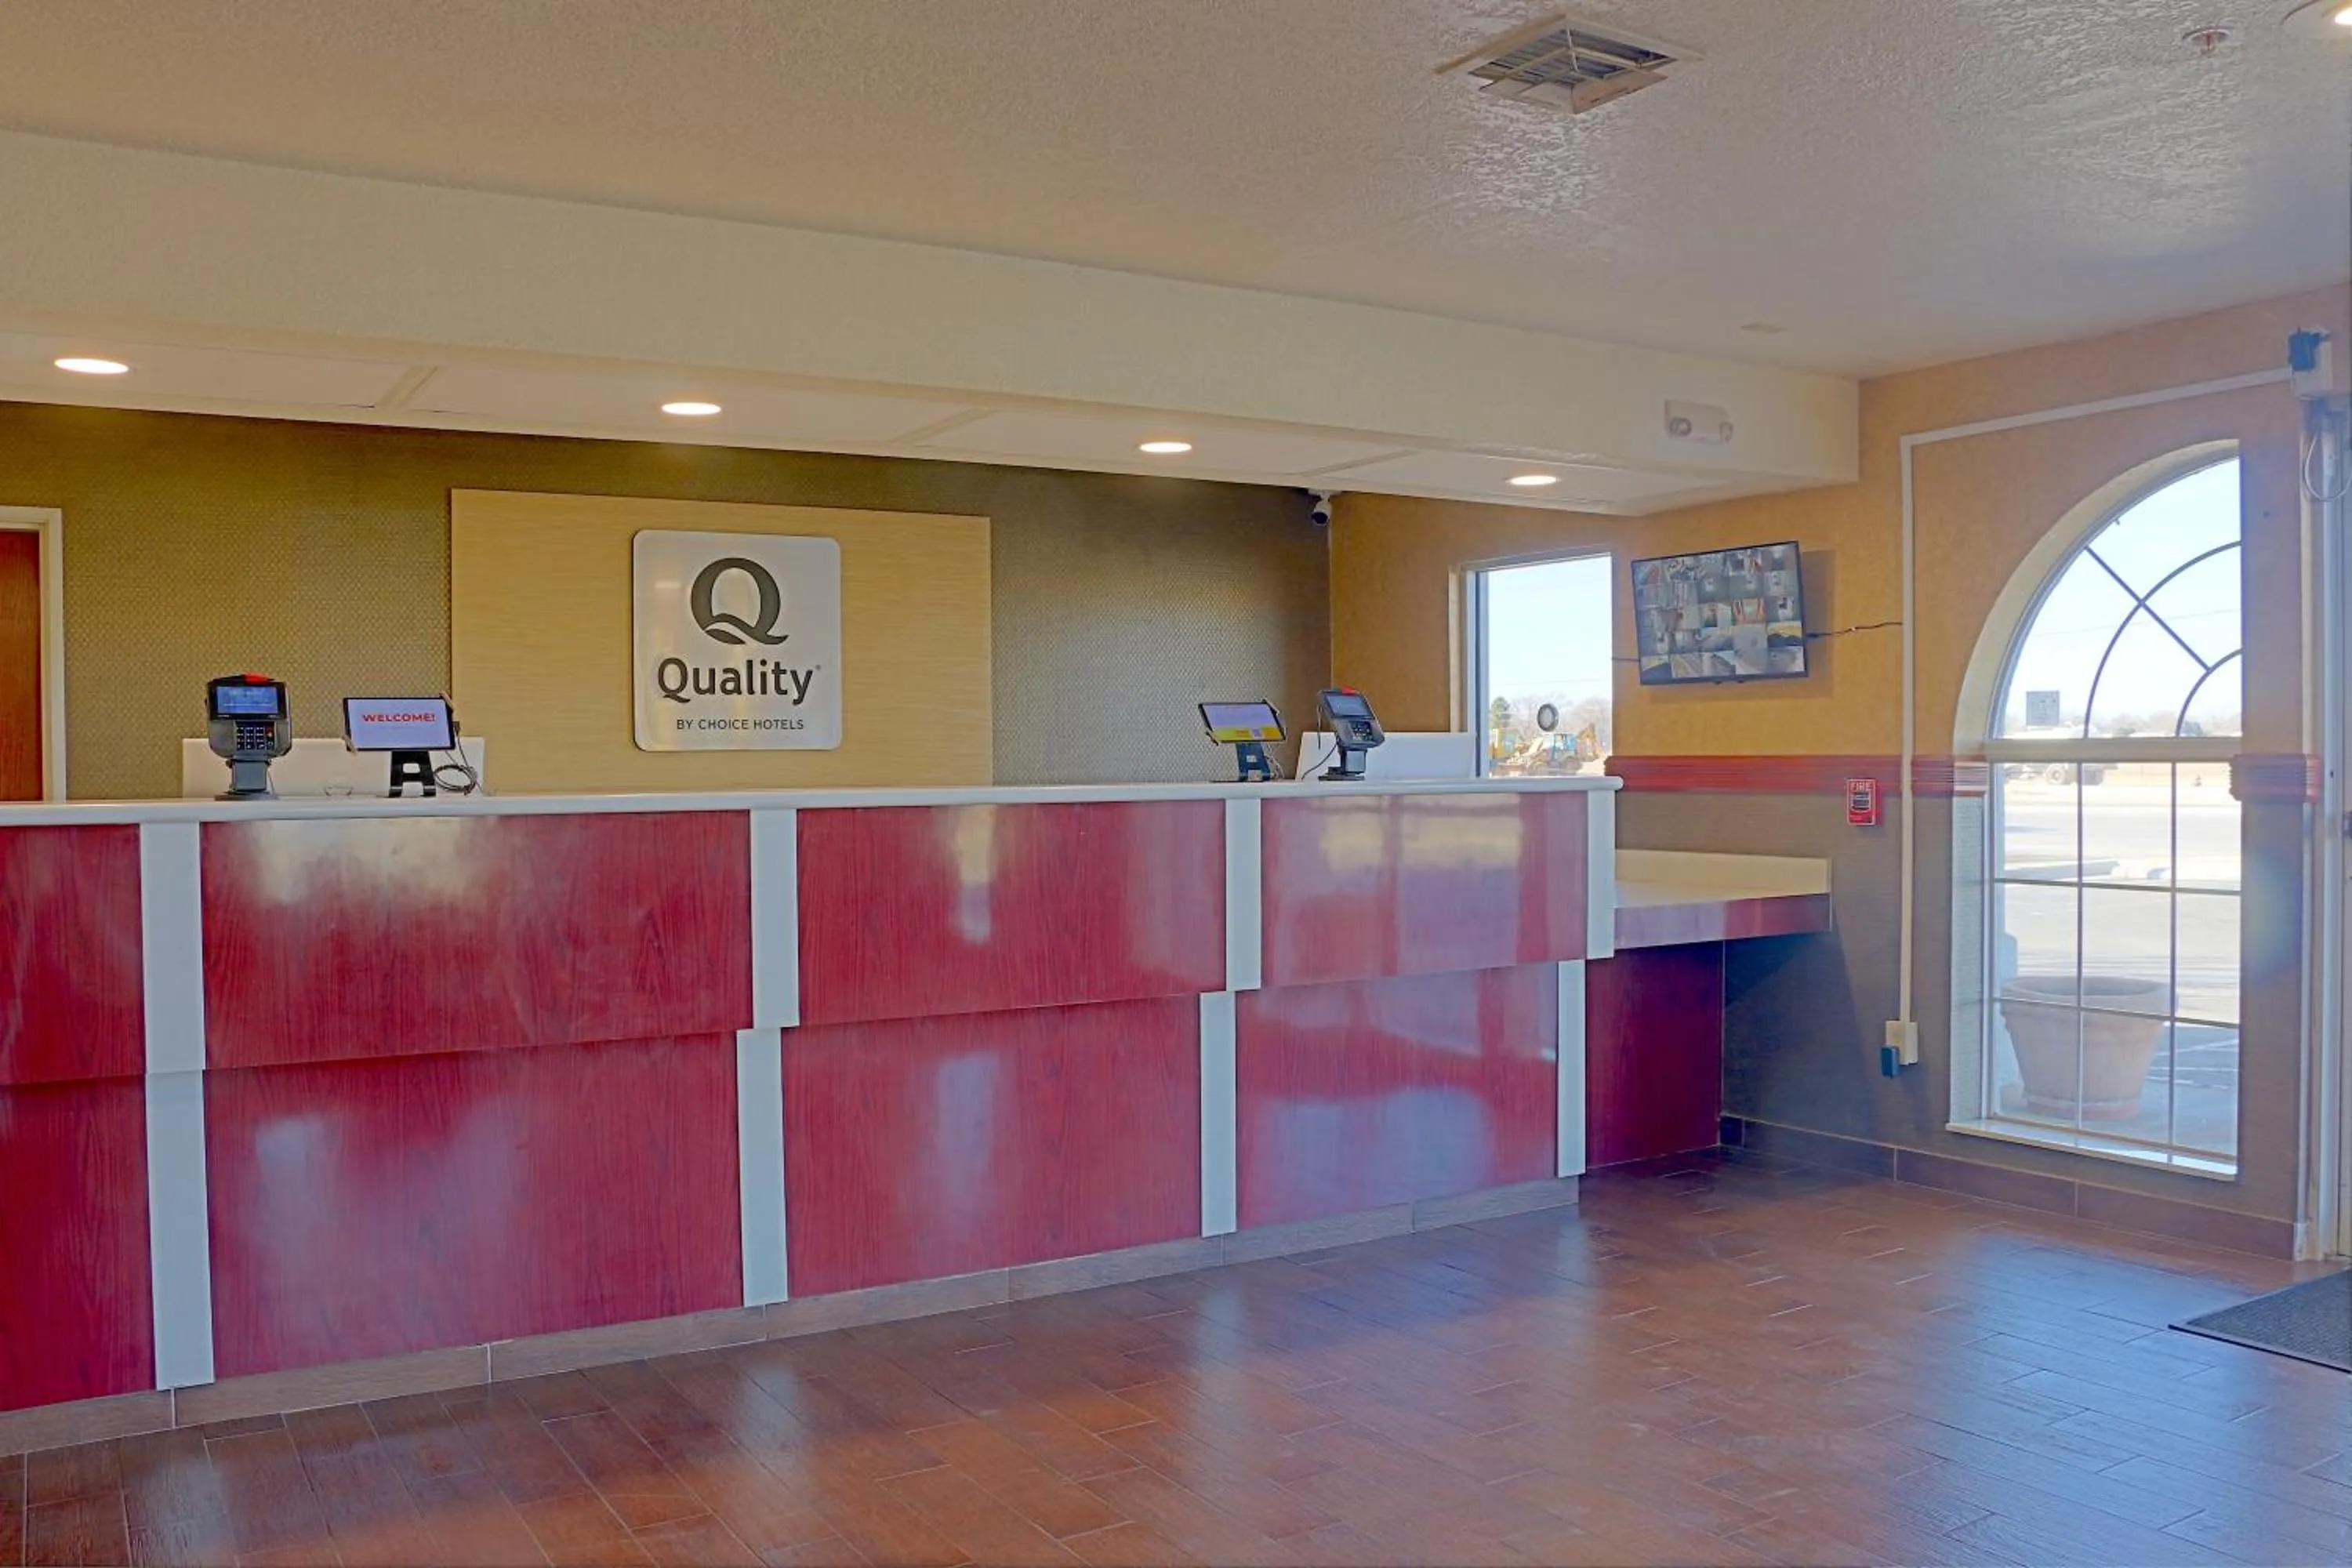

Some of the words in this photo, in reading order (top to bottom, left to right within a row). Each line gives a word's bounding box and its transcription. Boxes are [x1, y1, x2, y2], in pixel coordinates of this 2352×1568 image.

[691, 557, 789, 644] Q
[658, 657, 814, 706] Quality
[363, 713, 436, 722] WELCOME!
[677, 719, 693, 730] BY
[698, 719, 750, 730] CHOICE
[753, 719, 804, 730] HOTELS
